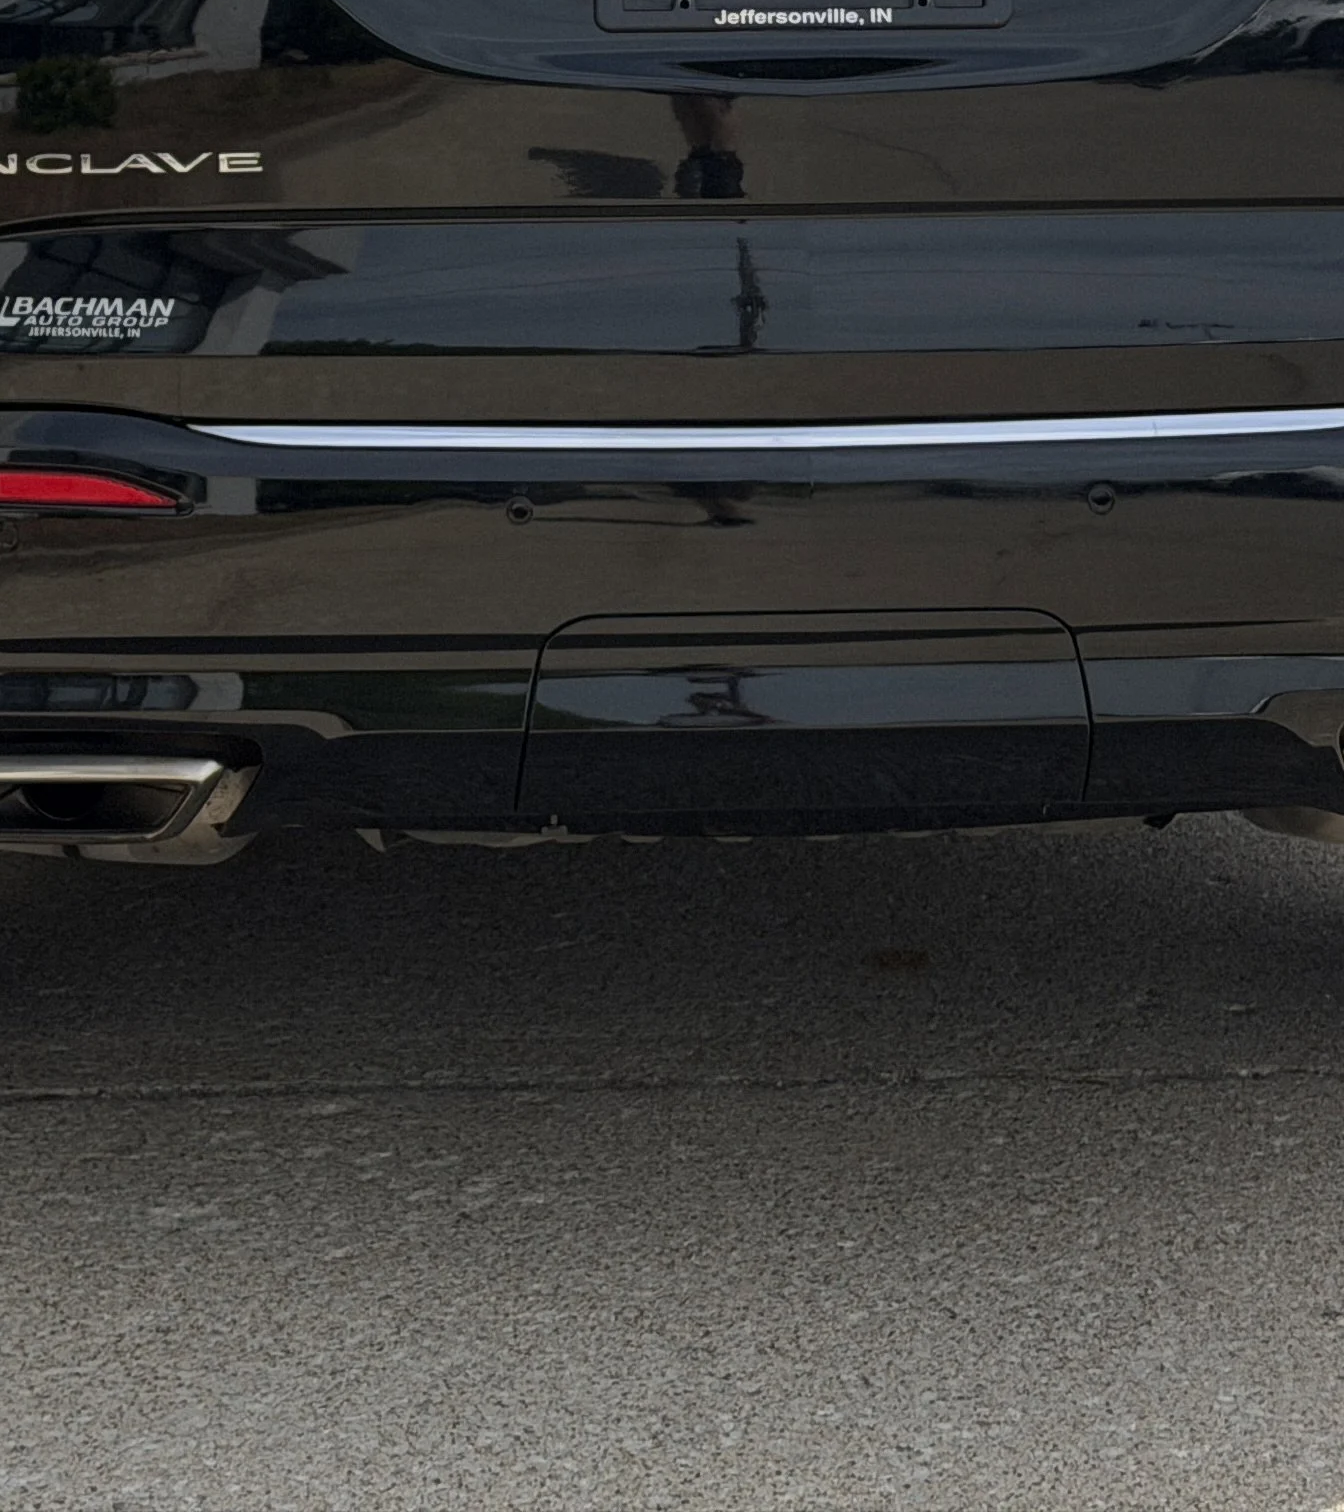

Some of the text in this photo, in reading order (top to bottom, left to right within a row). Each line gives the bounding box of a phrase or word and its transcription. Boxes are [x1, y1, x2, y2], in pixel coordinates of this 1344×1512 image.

[714, 8, 892, 26] Jeffersonville, IN
[11, 296, 175, 316] BACHMAN
[23, 316, 169, 327] AUTO GROUP
[28, 327, 141, 339] JEFFERSONVILLE, IN
